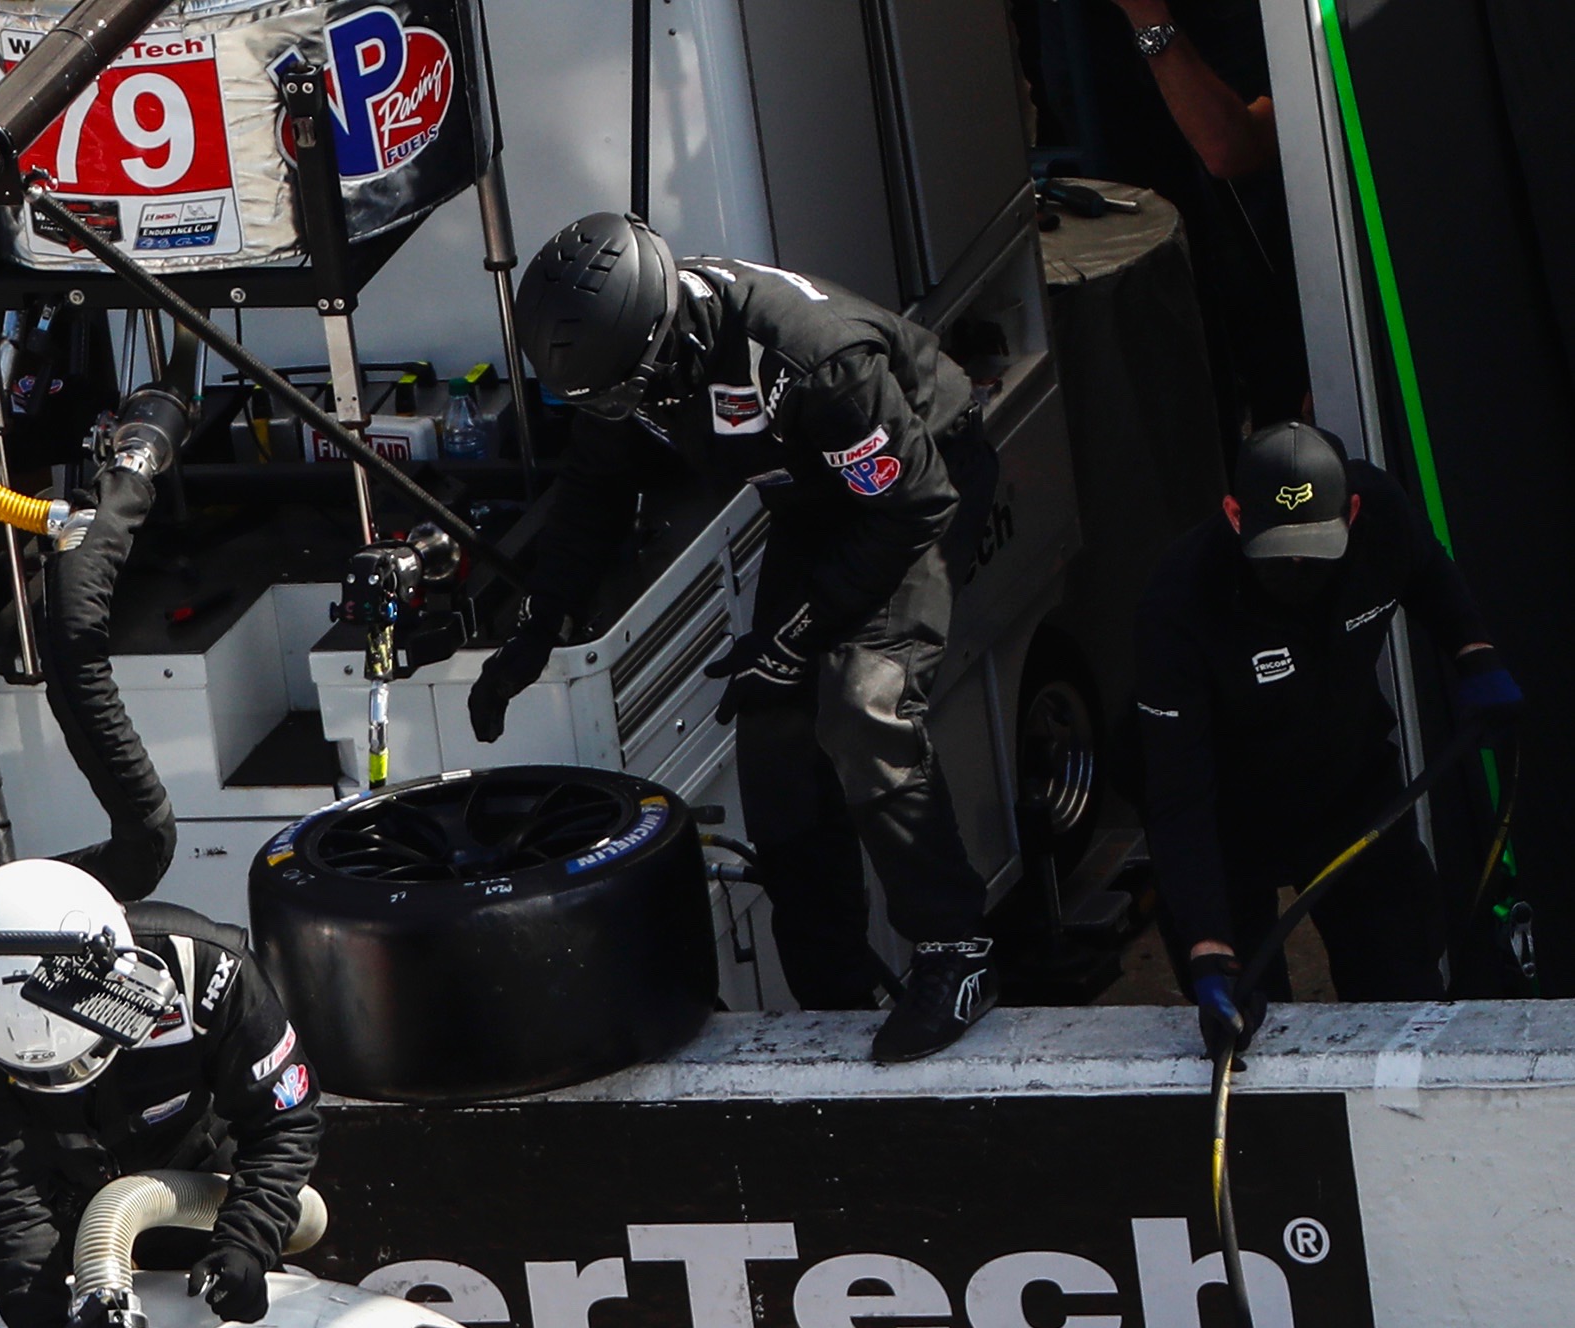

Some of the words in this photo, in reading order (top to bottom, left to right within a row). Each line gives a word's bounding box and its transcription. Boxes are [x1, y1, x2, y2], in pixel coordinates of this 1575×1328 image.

[378, 58, 446, 148] Racing
[386, 124, 439, 165] FUELS
[577, 809, 663, 868] MICHELIN
[201, 951, 235, 1011] HRX
